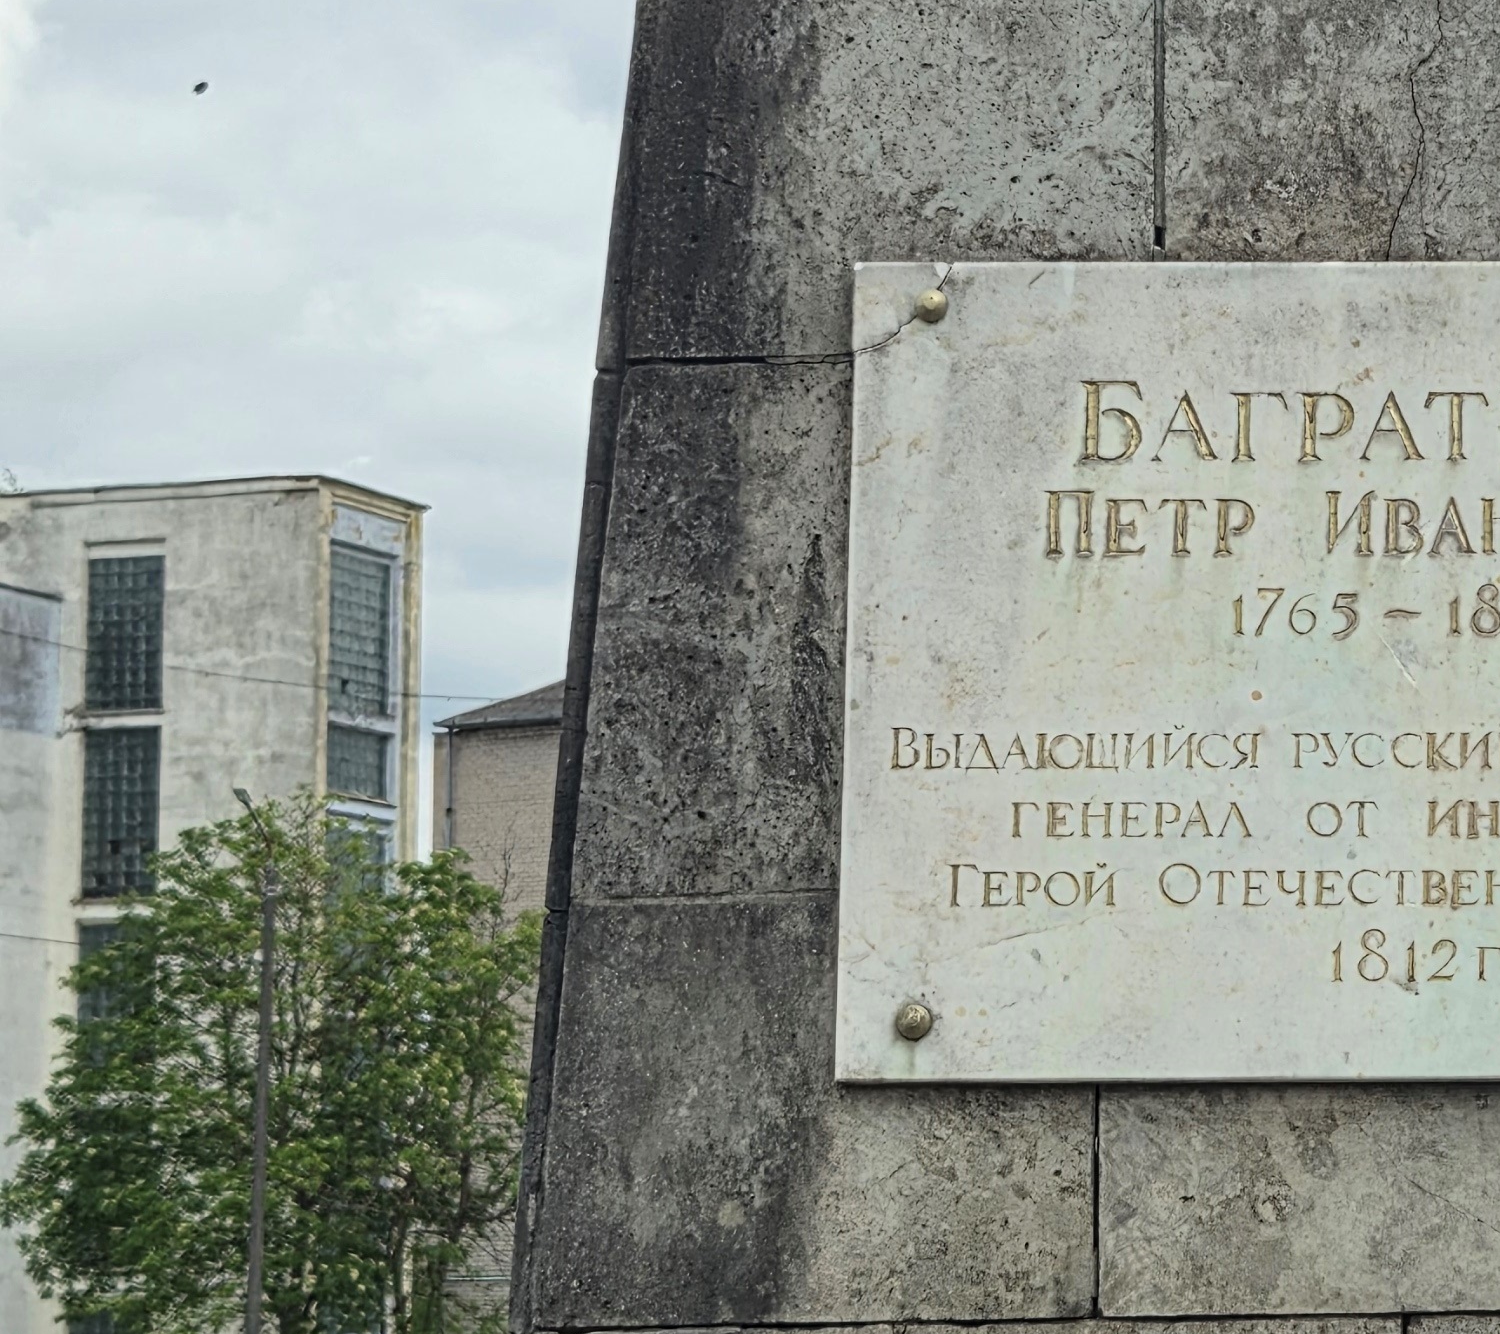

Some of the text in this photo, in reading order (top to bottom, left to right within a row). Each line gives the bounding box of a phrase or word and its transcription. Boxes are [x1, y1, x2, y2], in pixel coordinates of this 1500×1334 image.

[1044, 490, 1256, 559] ПЕТР
[1232, 587, 1360, 642] 1765
[890, 724, 1262, 774] ВЫДАЮЩИЙСЯ
[1010, 800, 1253, 838] ГЕНЕРАЛ
[1306, 800, 1380, 839] ОТ
[948, 862, 1118, 908] ГЕРОЙ
